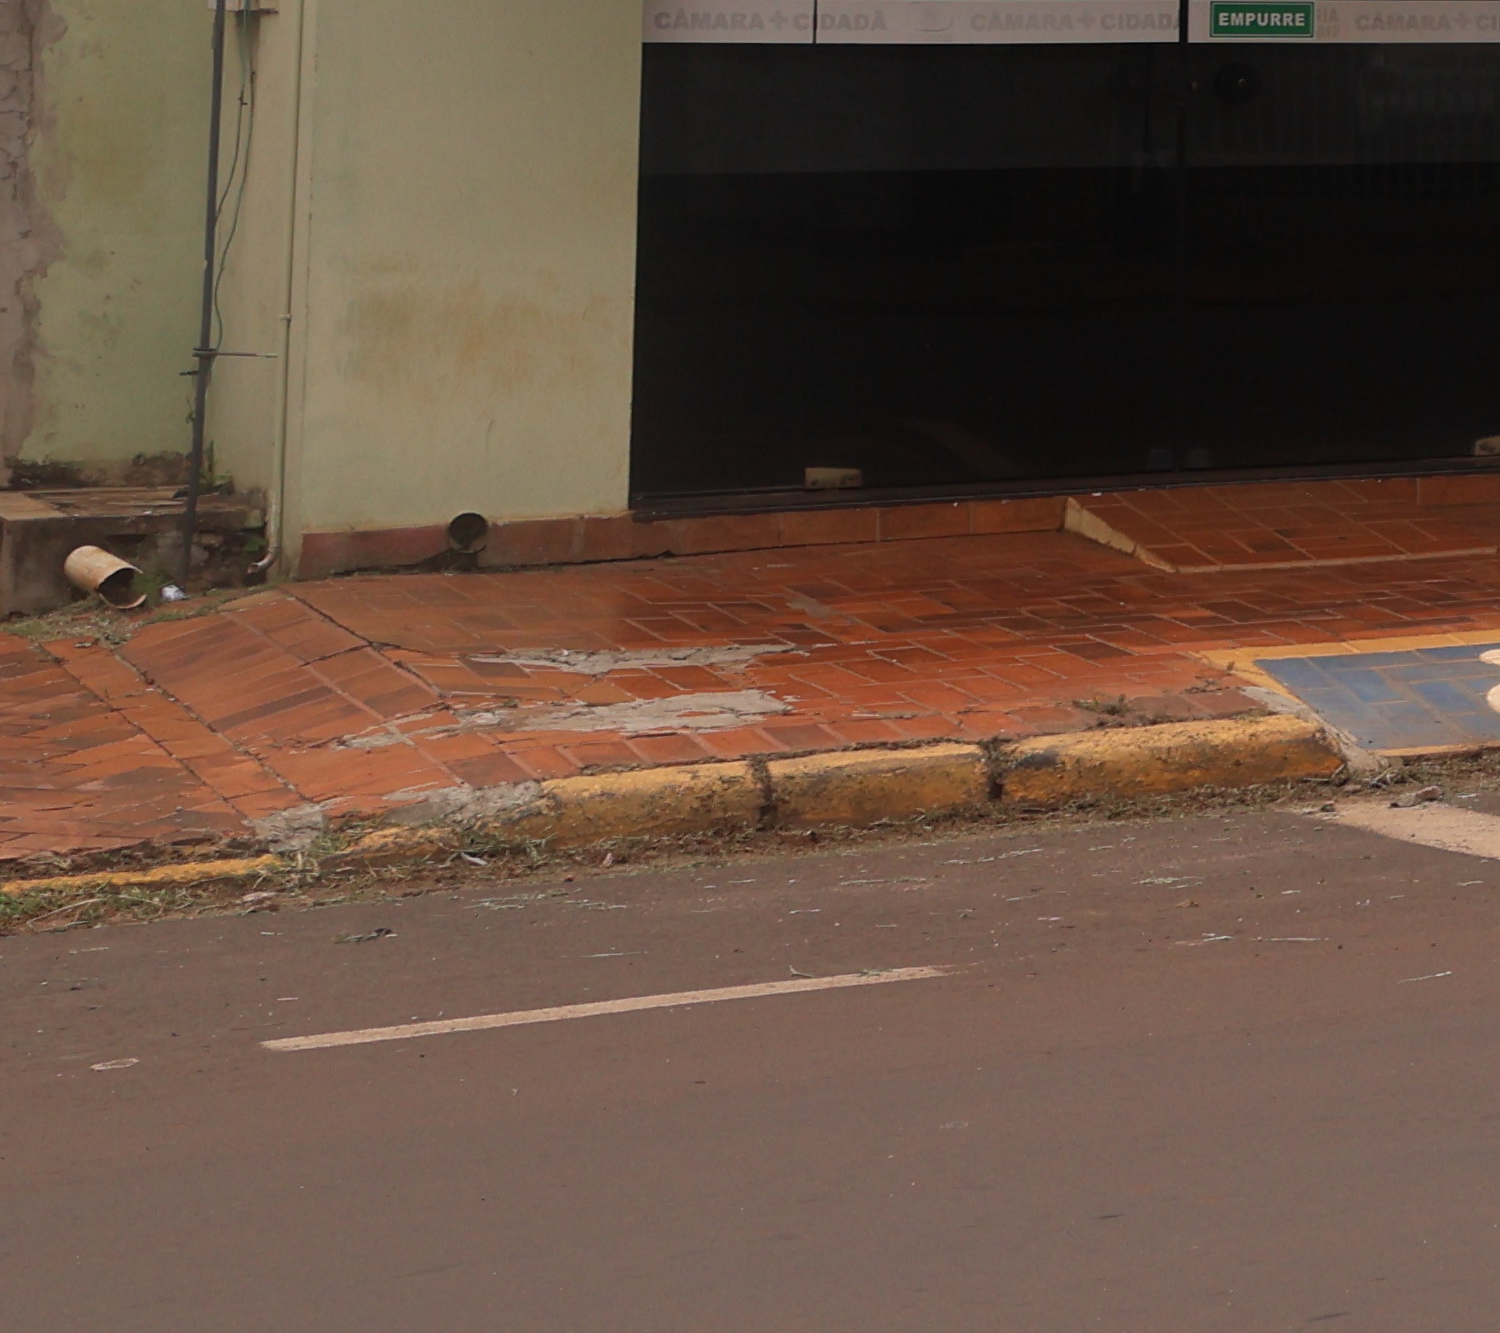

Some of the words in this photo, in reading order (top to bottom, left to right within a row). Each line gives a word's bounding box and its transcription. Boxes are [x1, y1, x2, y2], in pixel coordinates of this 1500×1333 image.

[653, 8, 765, 30] CÂMARA
[969, 9, 1074, 31] CÂMARA
[1218, 12, 1306, 27] EMPURRE
[1354, 9, 1451, 31] CÂMARA
